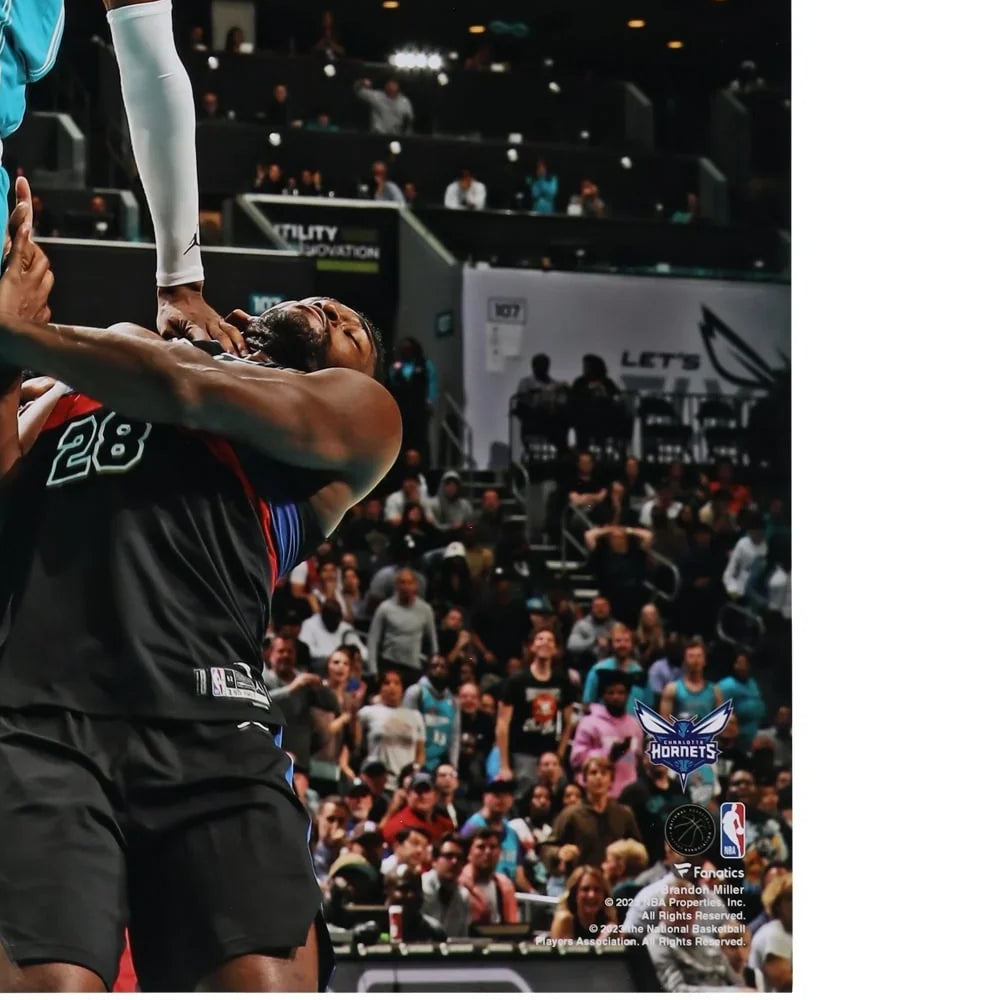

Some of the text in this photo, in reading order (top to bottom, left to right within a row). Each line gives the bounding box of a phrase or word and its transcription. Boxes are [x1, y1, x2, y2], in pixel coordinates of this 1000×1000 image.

[495, 303, 520, 318] 107
[620, 350, 701, 371] LET'S
[46, 410, 152, 486] 28
